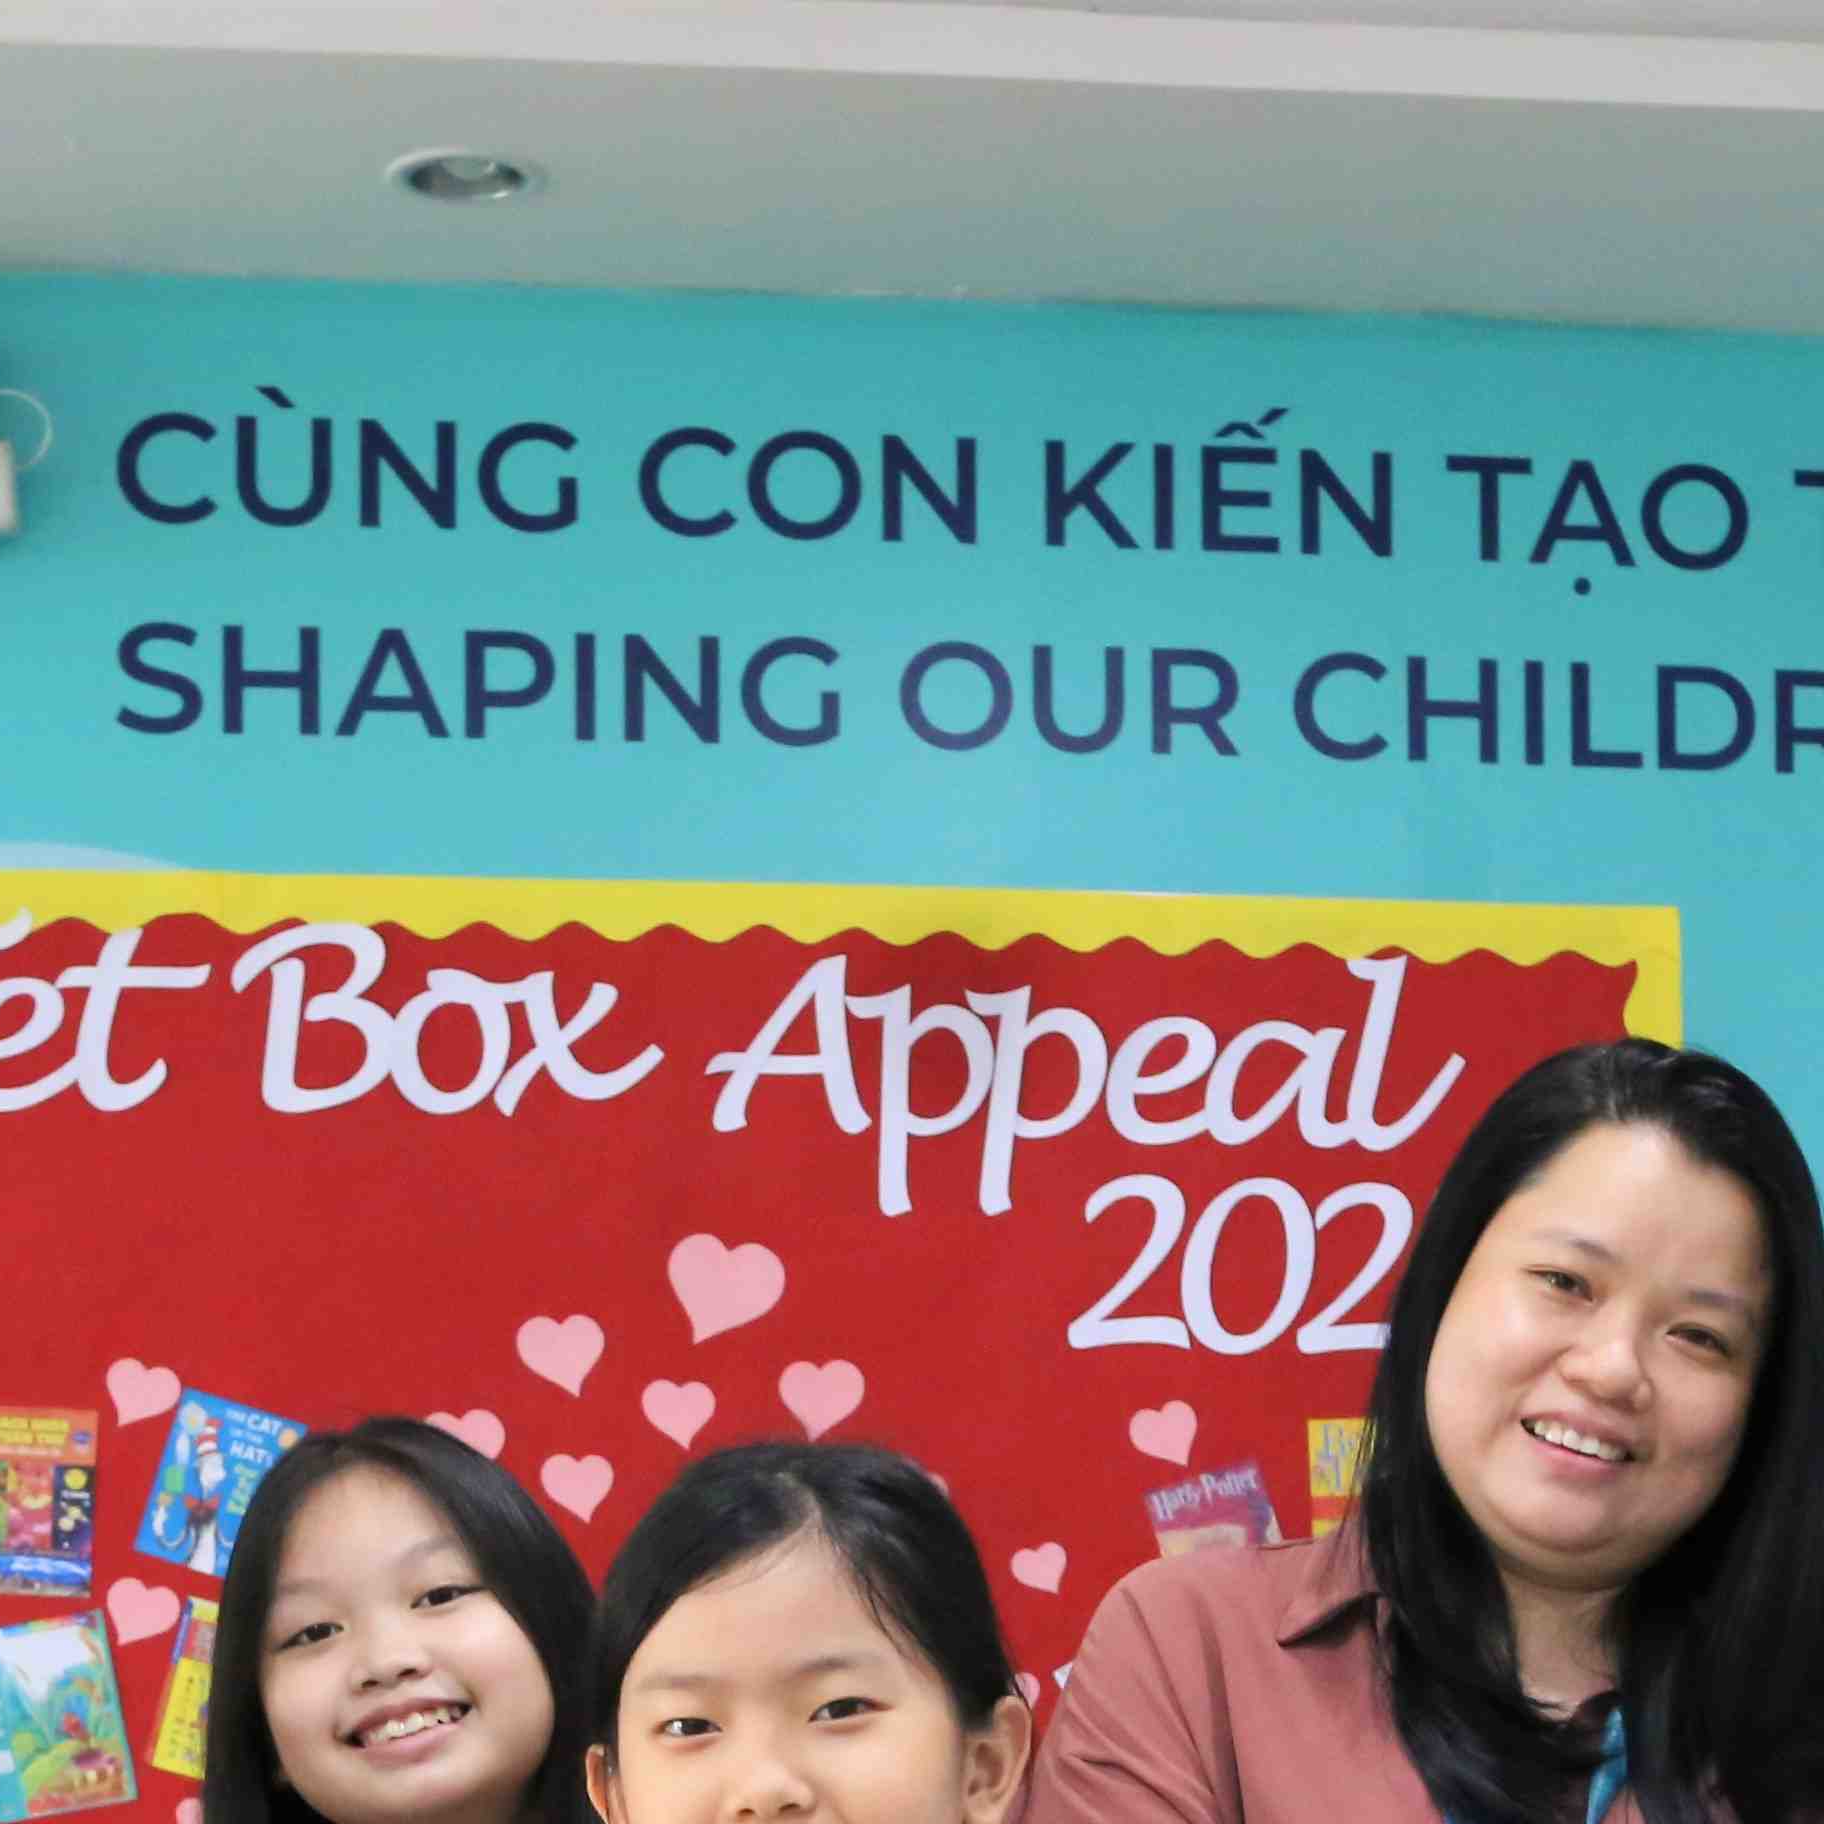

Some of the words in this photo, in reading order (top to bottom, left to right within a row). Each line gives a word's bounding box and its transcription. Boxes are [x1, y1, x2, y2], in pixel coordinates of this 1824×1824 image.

[115, 387, 579, 533] CÙNG
[639, 427, 979, 547] CON
[1046, 406, 1394, 561] KIẾN
[1447, 455, 1749, 596] TẠO
[115, 621, 842, 755] SHAPING
[899, 638, 1240, 758] OUR
[232, 922, 664, 1117] Box
[705, 955, 1465, 1217] Appeal
[1068, 1173, 1413, 1355] 202
